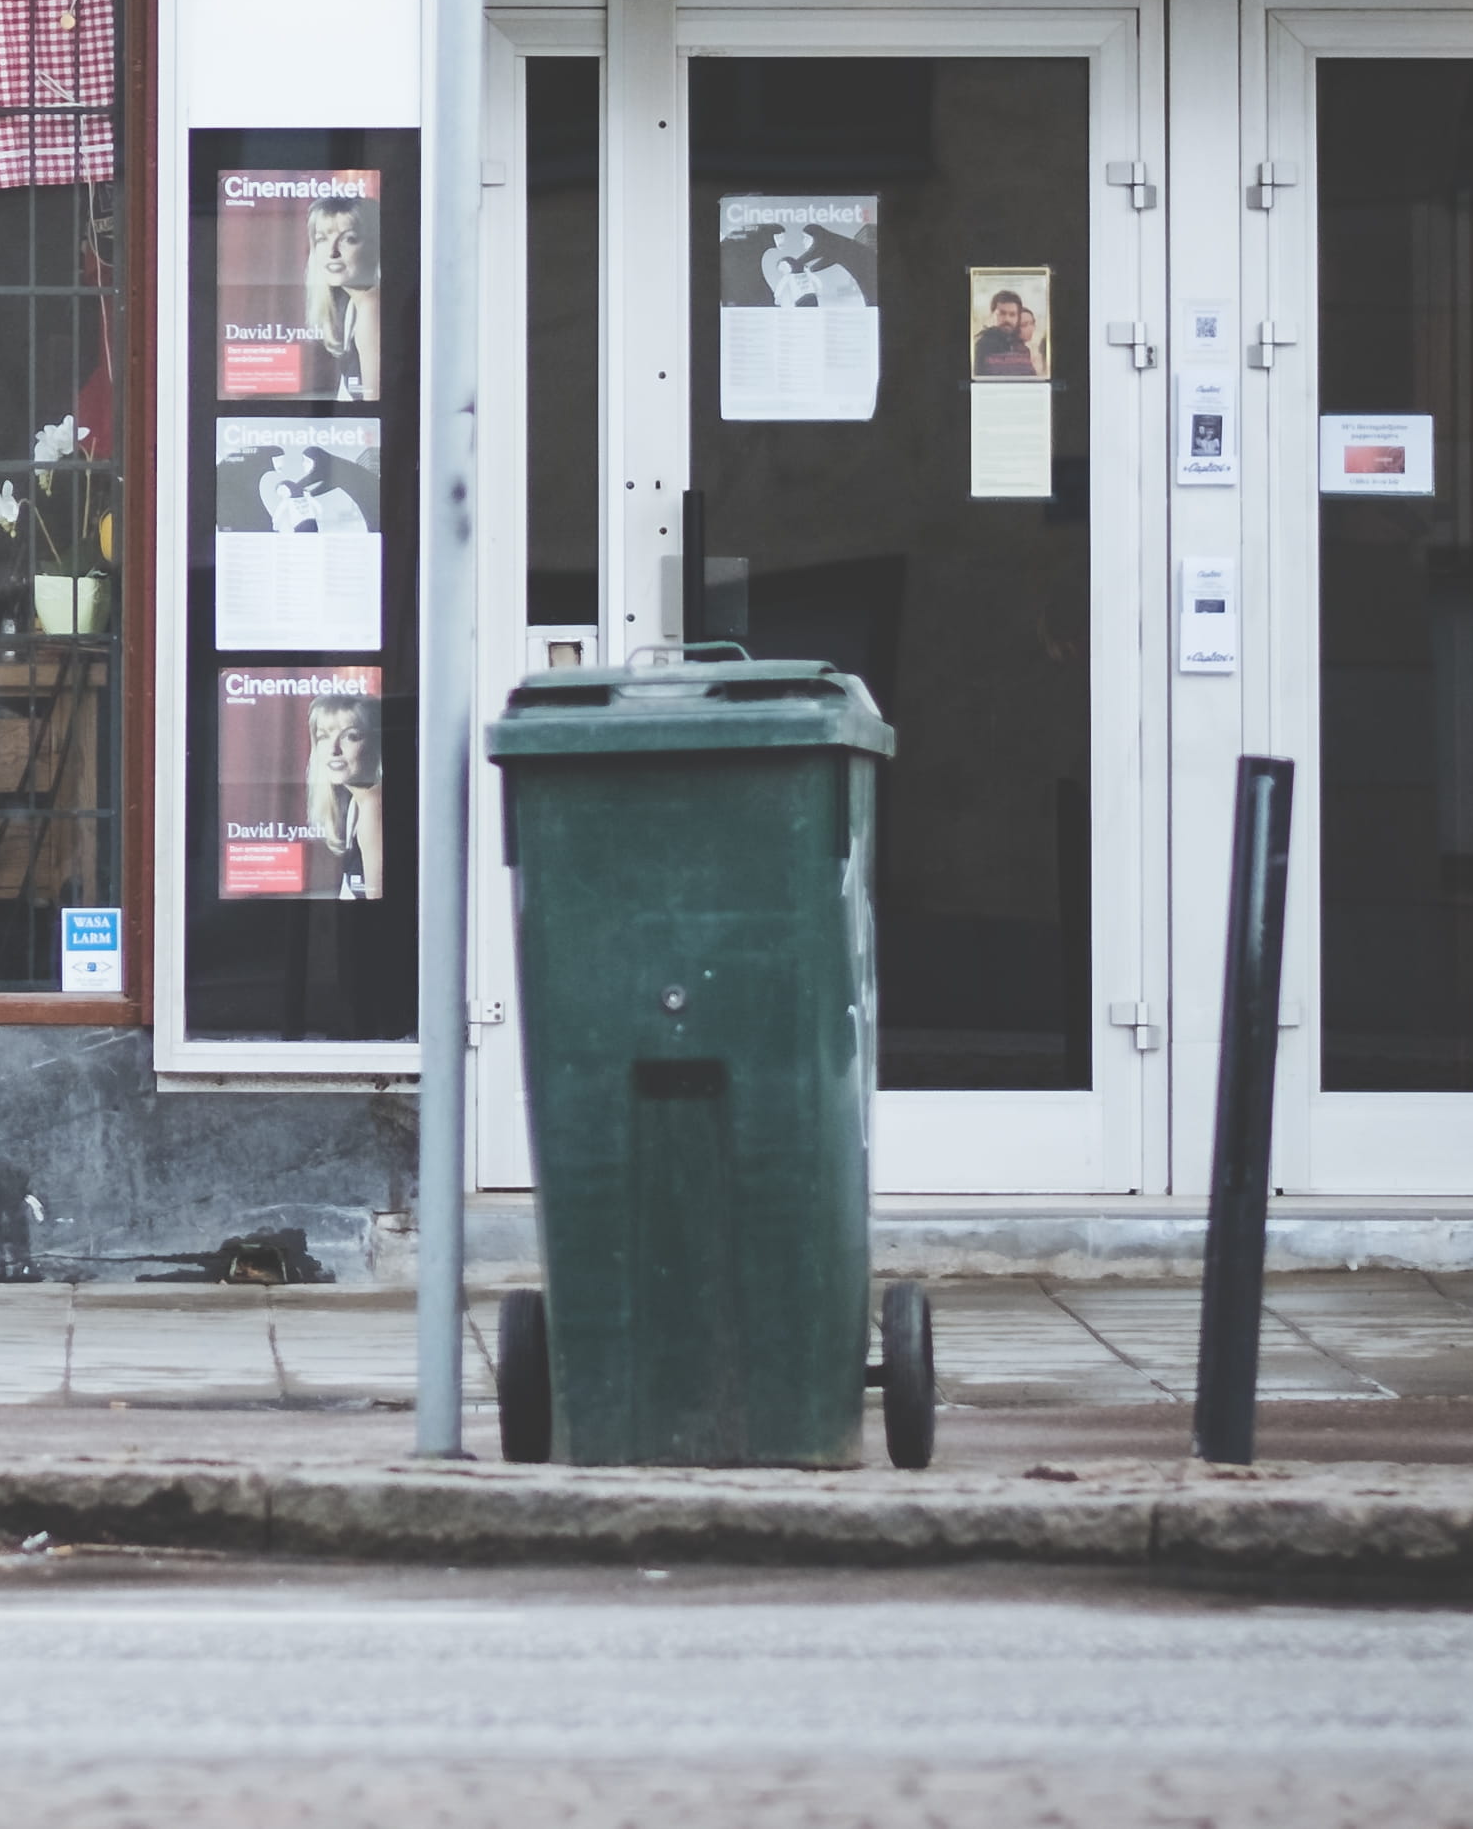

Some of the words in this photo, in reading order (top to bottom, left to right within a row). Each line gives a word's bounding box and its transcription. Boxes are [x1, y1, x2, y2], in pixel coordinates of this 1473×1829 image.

[224, 176, 366, 199] Cinemateket
[726, 203, 862, 223] Cinemateket
[225, 323, 272, 340] David
[276, 323, 324, 343] Lynch
[224, 424, 365, 445] Cinemateket
[225, 673, 368, 695] Cinemateket
[227, 821, 274, 839] David
[277, 822, 326, 842] Lynch
[73, 916, 111, 928] WASA
[72, 932, 112, 945] LARM
